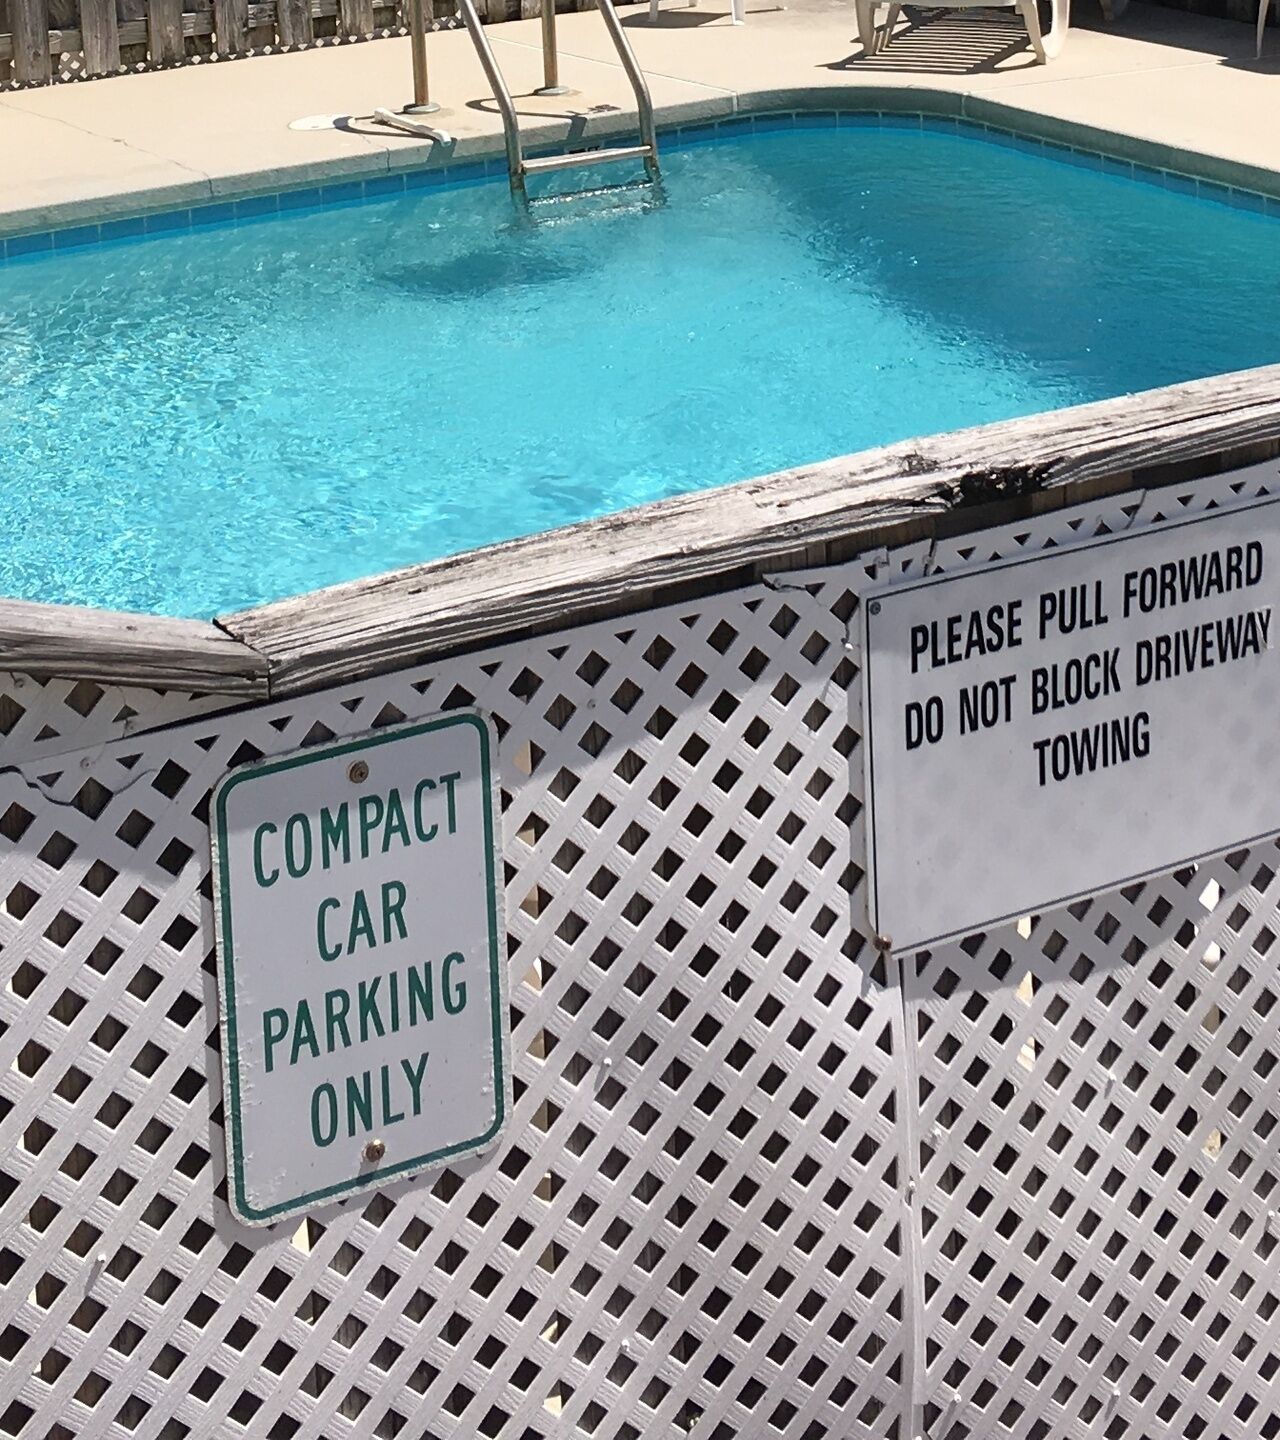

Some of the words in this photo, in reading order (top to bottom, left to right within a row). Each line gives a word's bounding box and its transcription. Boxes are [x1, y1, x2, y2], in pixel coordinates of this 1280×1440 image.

[910, 600, 1023, 674] PLEASE
[1038, 579, 1109, 640] PULL
[1122, 540, 1264, 618] FORWARD
[904, 694, 944, 751] DO
[958, 675, 1017, 736] NOT
[1030, 646, 1121, 716] BLOCK
[1135, 607, 1273, 687] DRIVEWAY
[1032, 710, 1151, 787] TOWING
[252, 770, 462, 889] COMPACT
[316, 879, 409, 963] CAR
[261, 950, 469, 1074] PARKING
[310, 1051, 430, 1148] ONLY
